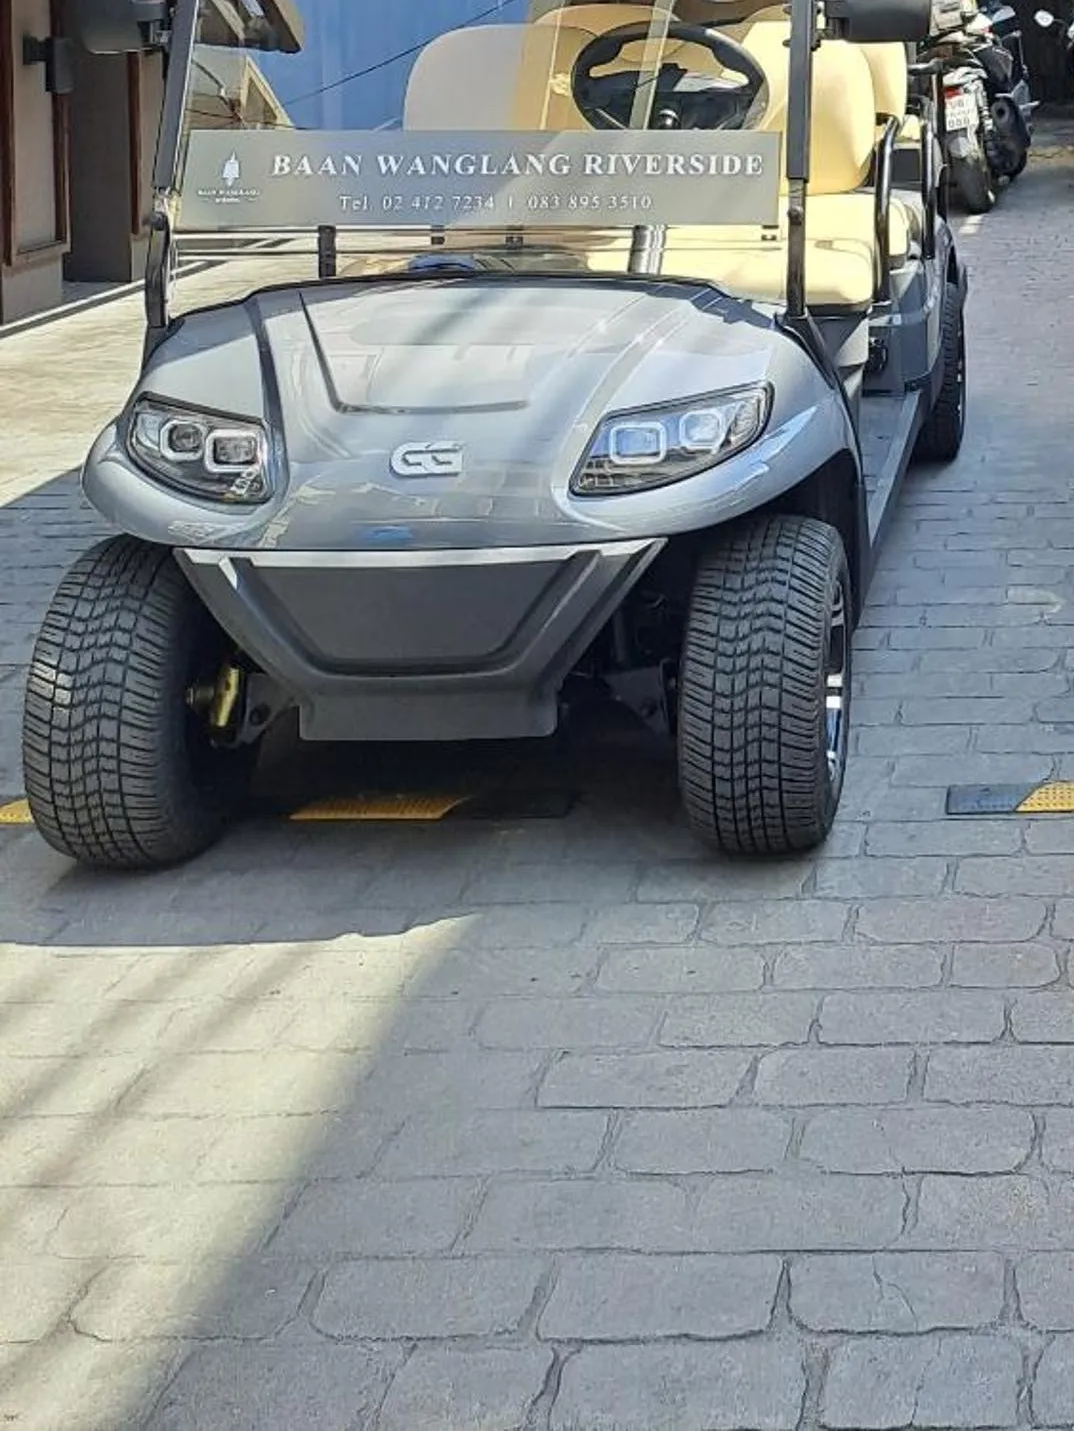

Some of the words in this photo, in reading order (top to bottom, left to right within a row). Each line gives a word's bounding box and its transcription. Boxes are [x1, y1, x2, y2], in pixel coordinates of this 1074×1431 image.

[273, 153, 362, 176] BAAN
[377, 153, 571, 176] WANGLANG
[584, 153, 764, 176] RIVERSIDE
[340, 195, 373, 212] Tel.
[382, 195, 402, 211] 02
[411, 195, 443, 211] 412
[451, 195, 495, 211] 7234
[527, 195, 560, 210] 083
[568, 195, 601, 210] 895
[608, 195, 652, 210] 3510
